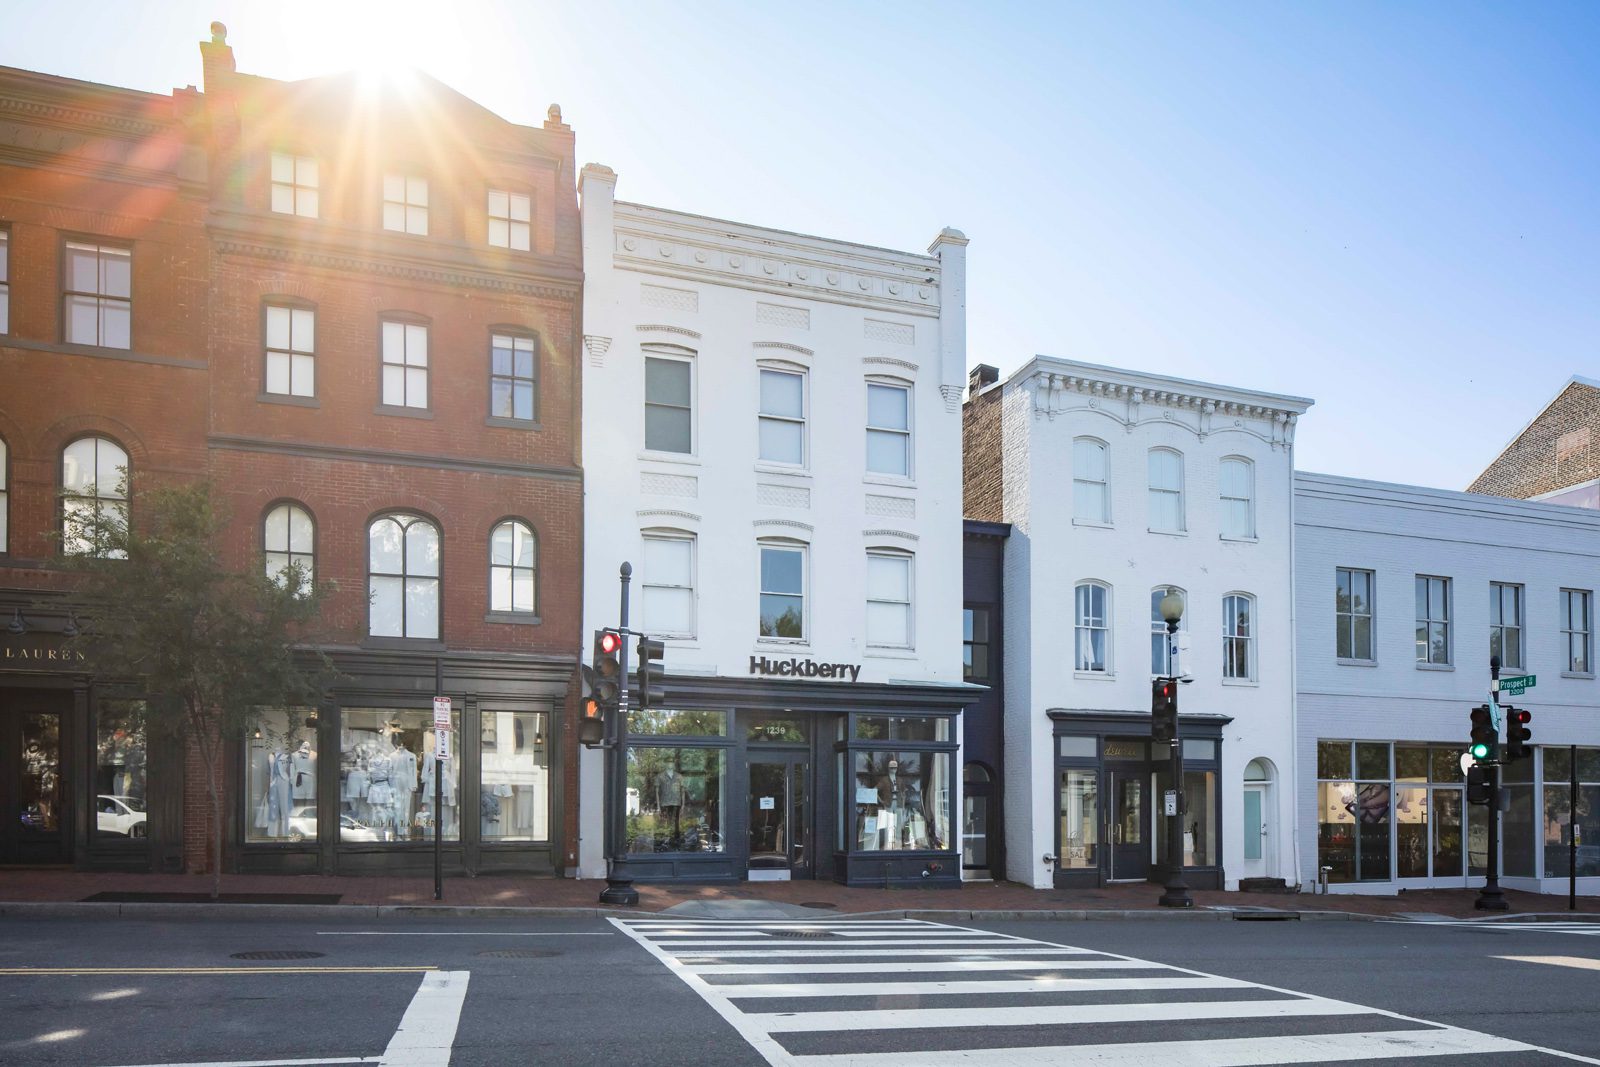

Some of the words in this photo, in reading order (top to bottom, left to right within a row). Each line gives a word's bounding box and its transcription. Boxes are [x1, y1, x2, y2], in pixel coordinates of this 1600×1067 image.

[6, 647, 86, 661] LAUREN
[749, 656, 861, 683] Huckberry
[1500, 678, 1527, 690] Prospect
[766, 726, 786, 735] 1239
